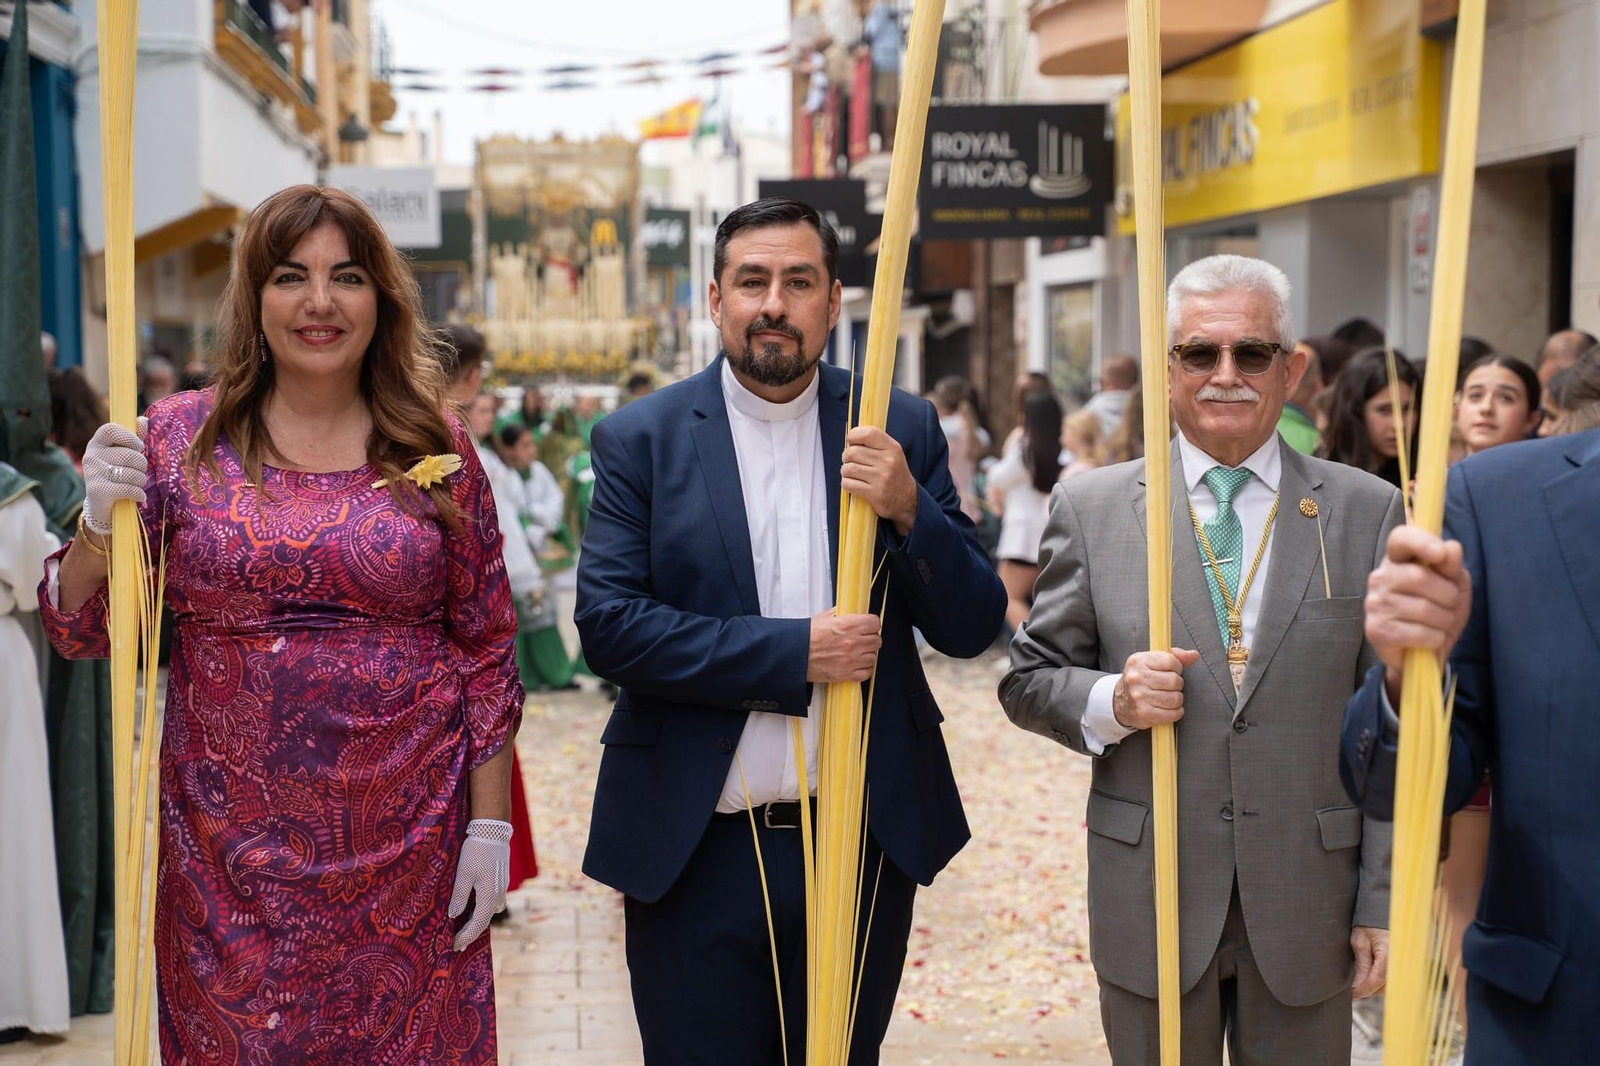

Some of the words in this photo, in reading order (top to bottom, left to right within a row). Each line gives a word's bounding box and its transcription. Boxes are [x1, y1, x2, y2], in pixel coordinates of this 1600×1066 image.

[931, 131, 1019, 159] ROYAL
[1188, 96, 1261, 174] FINCAS
[931, 160, 1029, 188] FINCAS
[344, 184, 429, 212] alani
